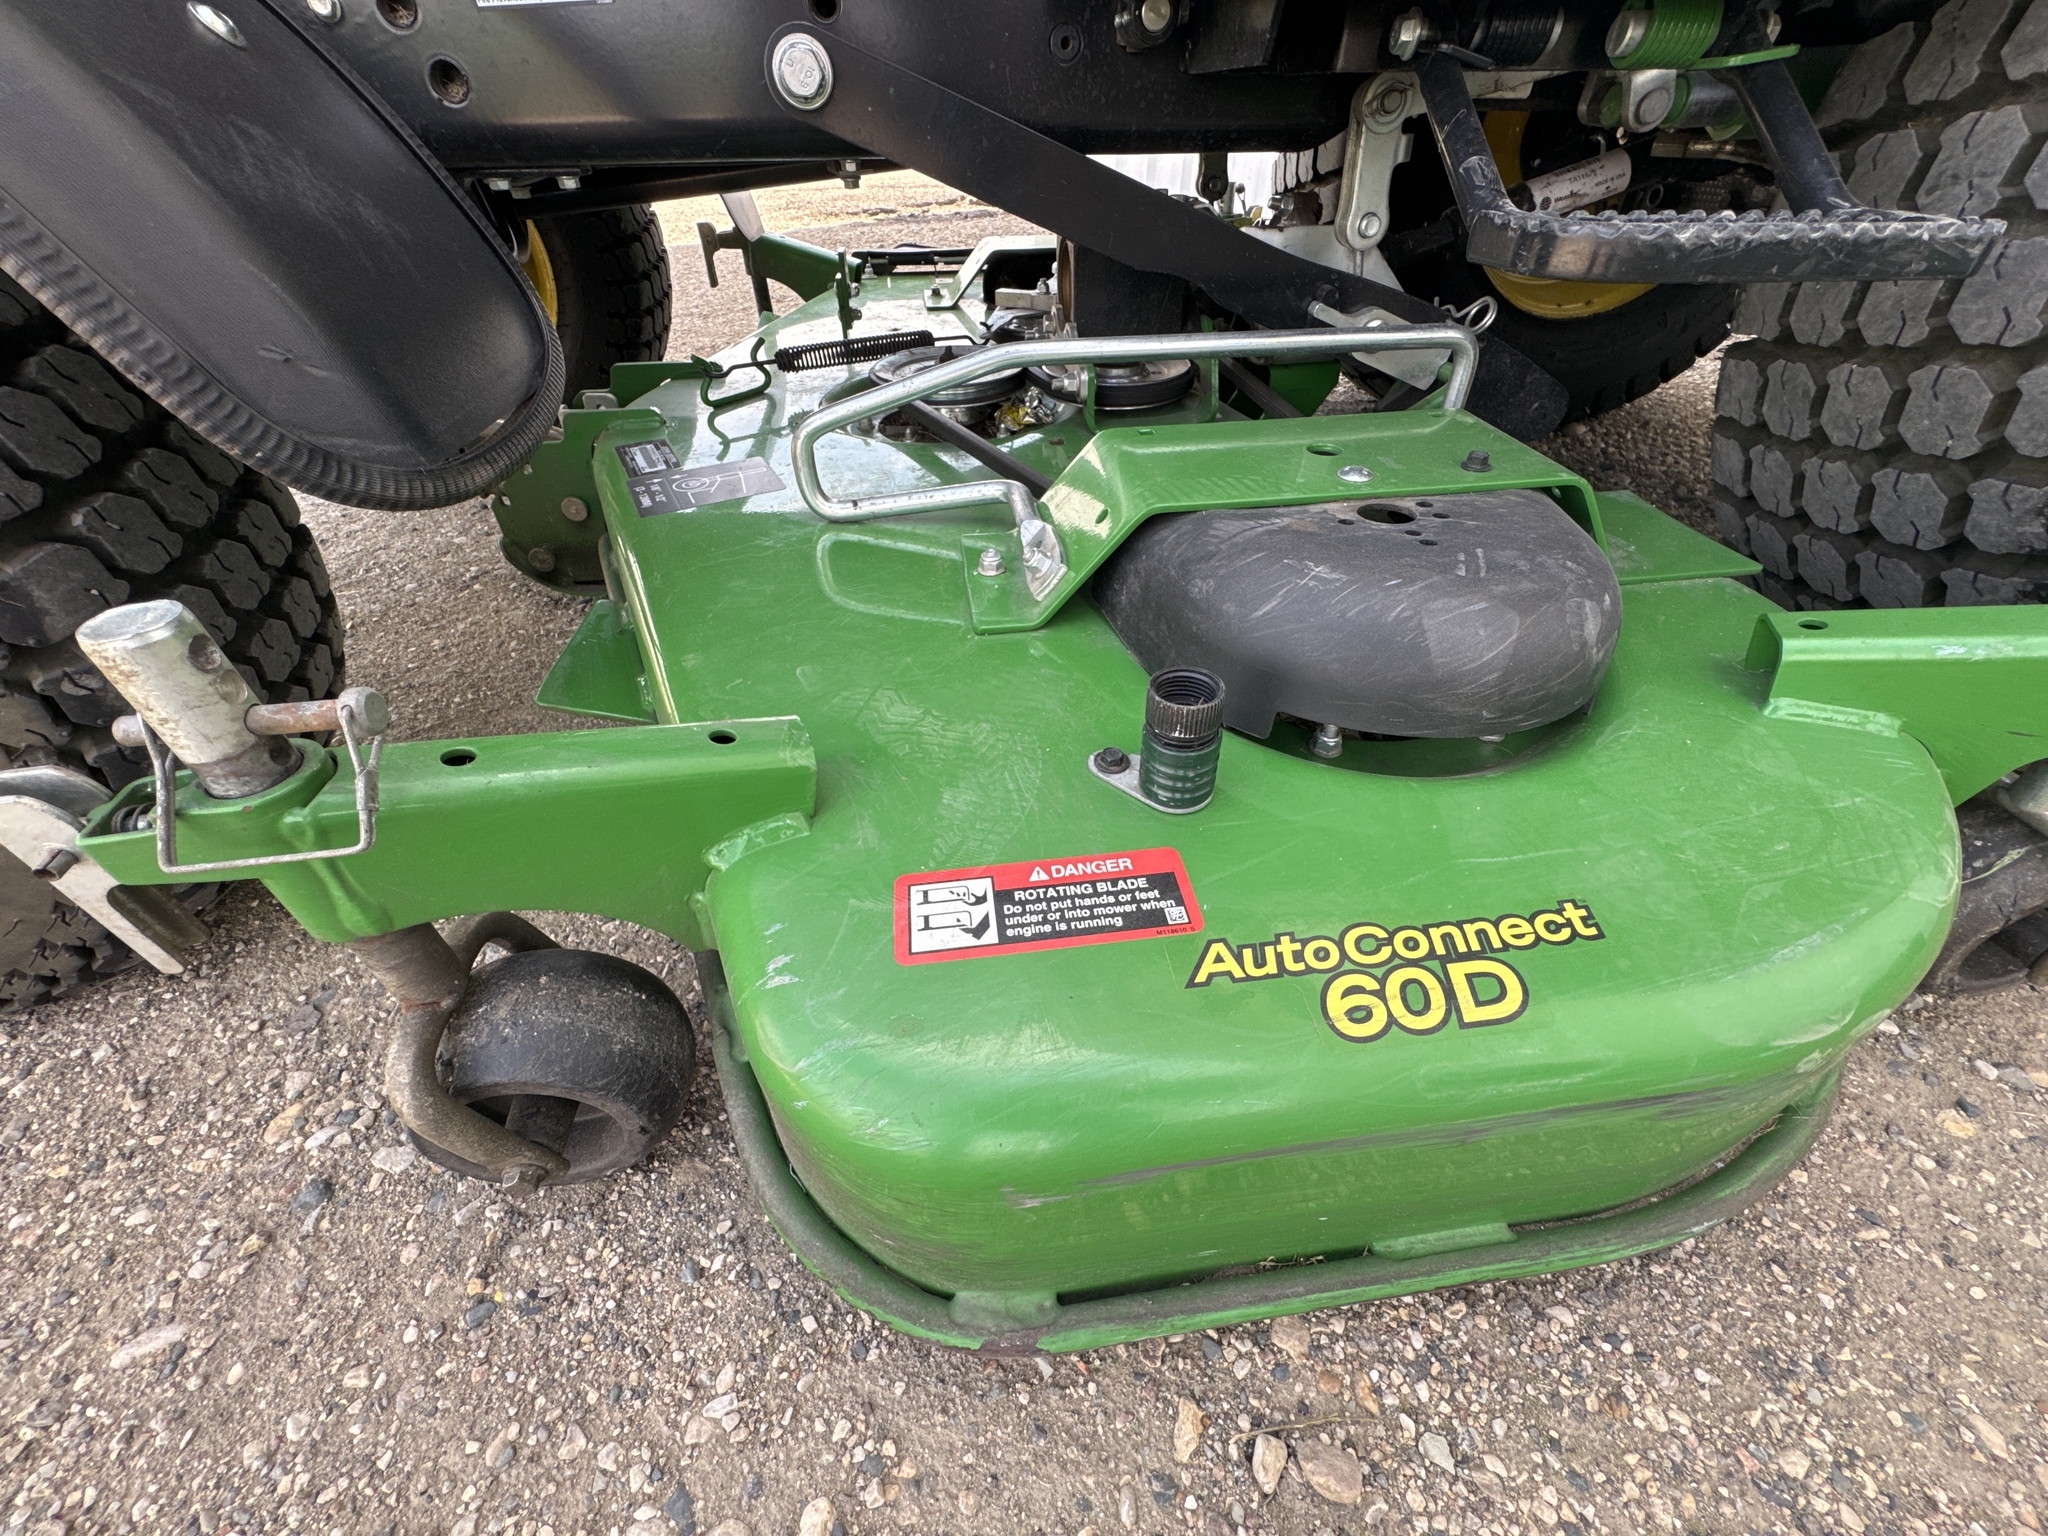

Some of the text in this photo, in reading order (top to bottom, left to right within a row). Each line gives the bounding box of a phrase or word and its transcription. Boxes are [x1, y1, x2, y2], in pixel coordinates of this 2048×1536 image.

[1050, 857, 1133, 878] DANGER
[1003, 889, 1160, 914] Do not put hands or feet
[1014, 878, 1149, 901] ROTATING BLADE
[1005, 899, 1176, 925] under or into mower when
[1006, 916, 1123, 937] engine is running
[1185, 900, 1605, 988] AutoConnect
[1321, 957, 1528, 1042] 60D
